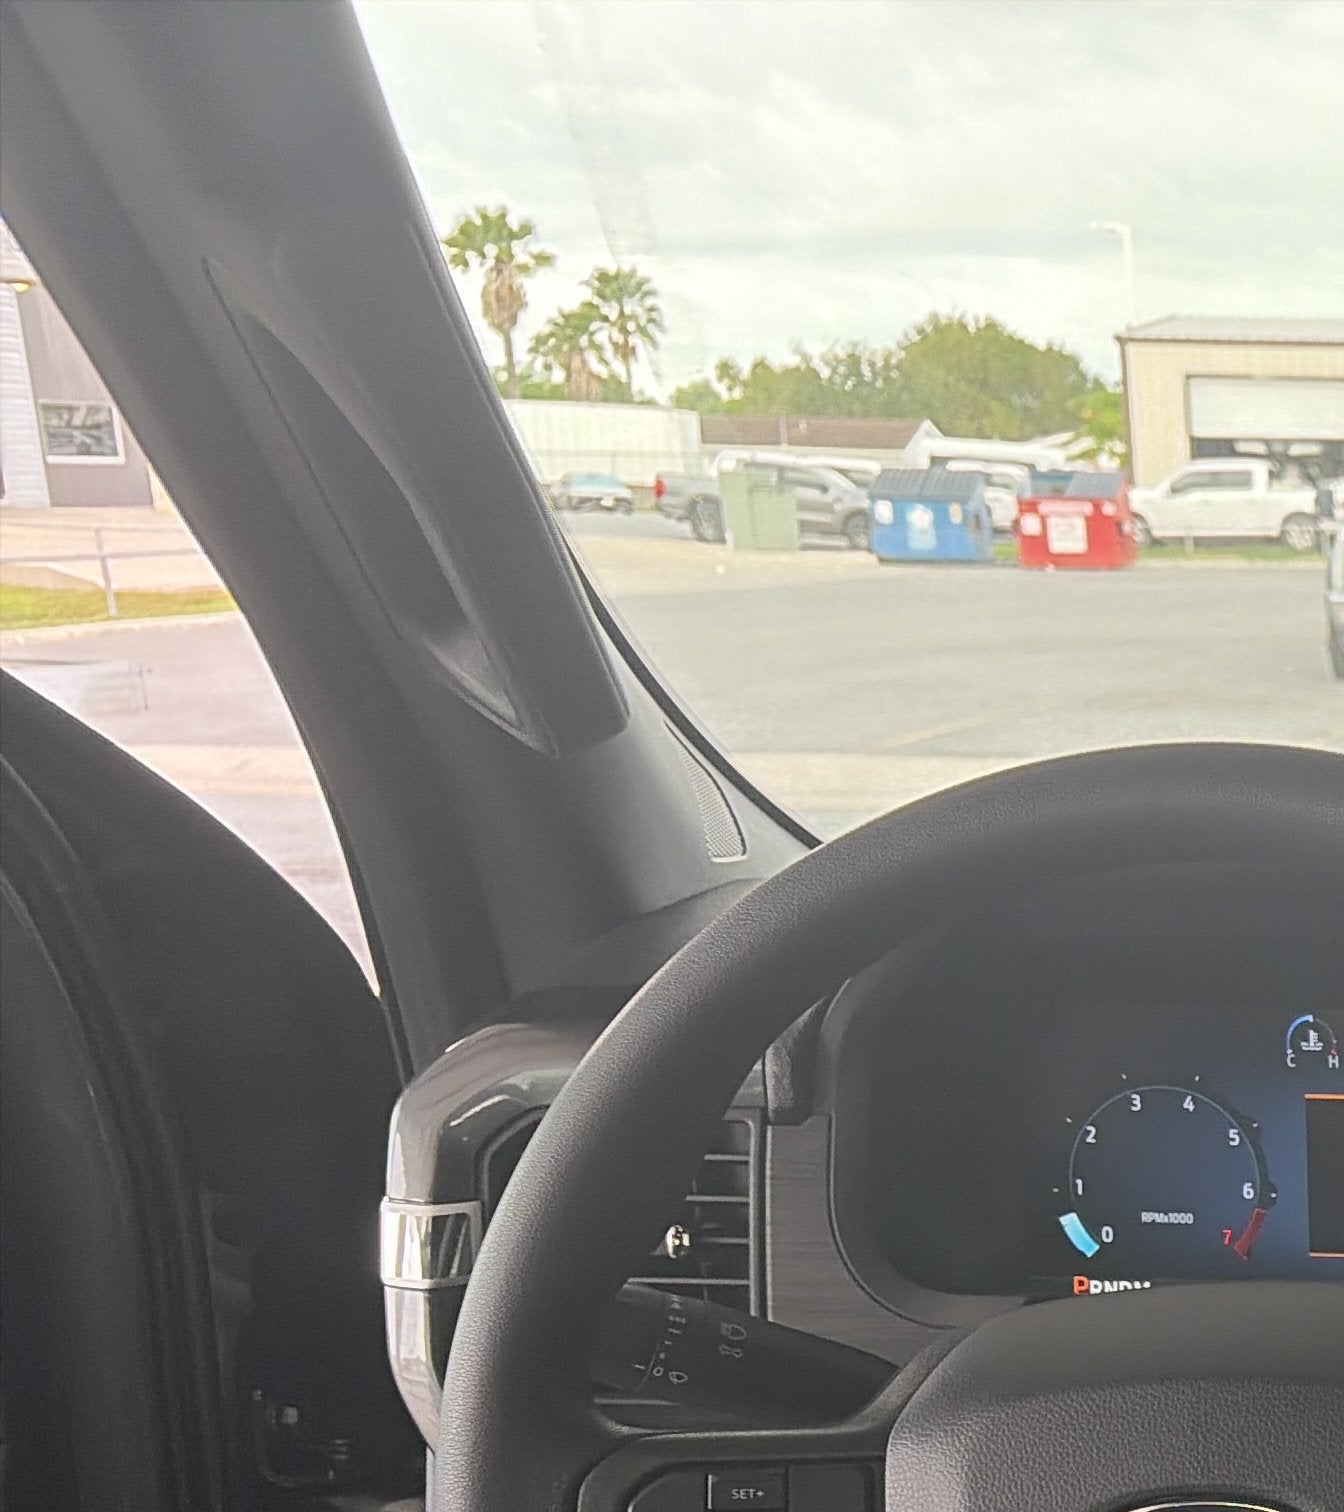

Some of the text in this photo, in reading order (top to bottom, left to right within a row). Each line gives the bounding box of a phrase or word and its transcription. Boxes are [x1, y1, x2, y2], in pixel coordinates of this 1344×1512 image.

[1286, 1056, 1297, 1068] C
[1327, 1055, 1339, 1069] H
[1130, 1094, 1142, 1111] 3
[1182, 1095, 1195, 1112] 4
[1085, 1125, 1097, 1143] 2
[1228, 1128, 1240, 1146] 5
[1075, 1178, 1083, 1196] 1
[1242, 1182, 1254, 1200] 6
[1101, 1225, 1114, 1243] 0
[1222, 1229, 1233, 1245] 7
[731, 1488, 765, 1500] SET+
